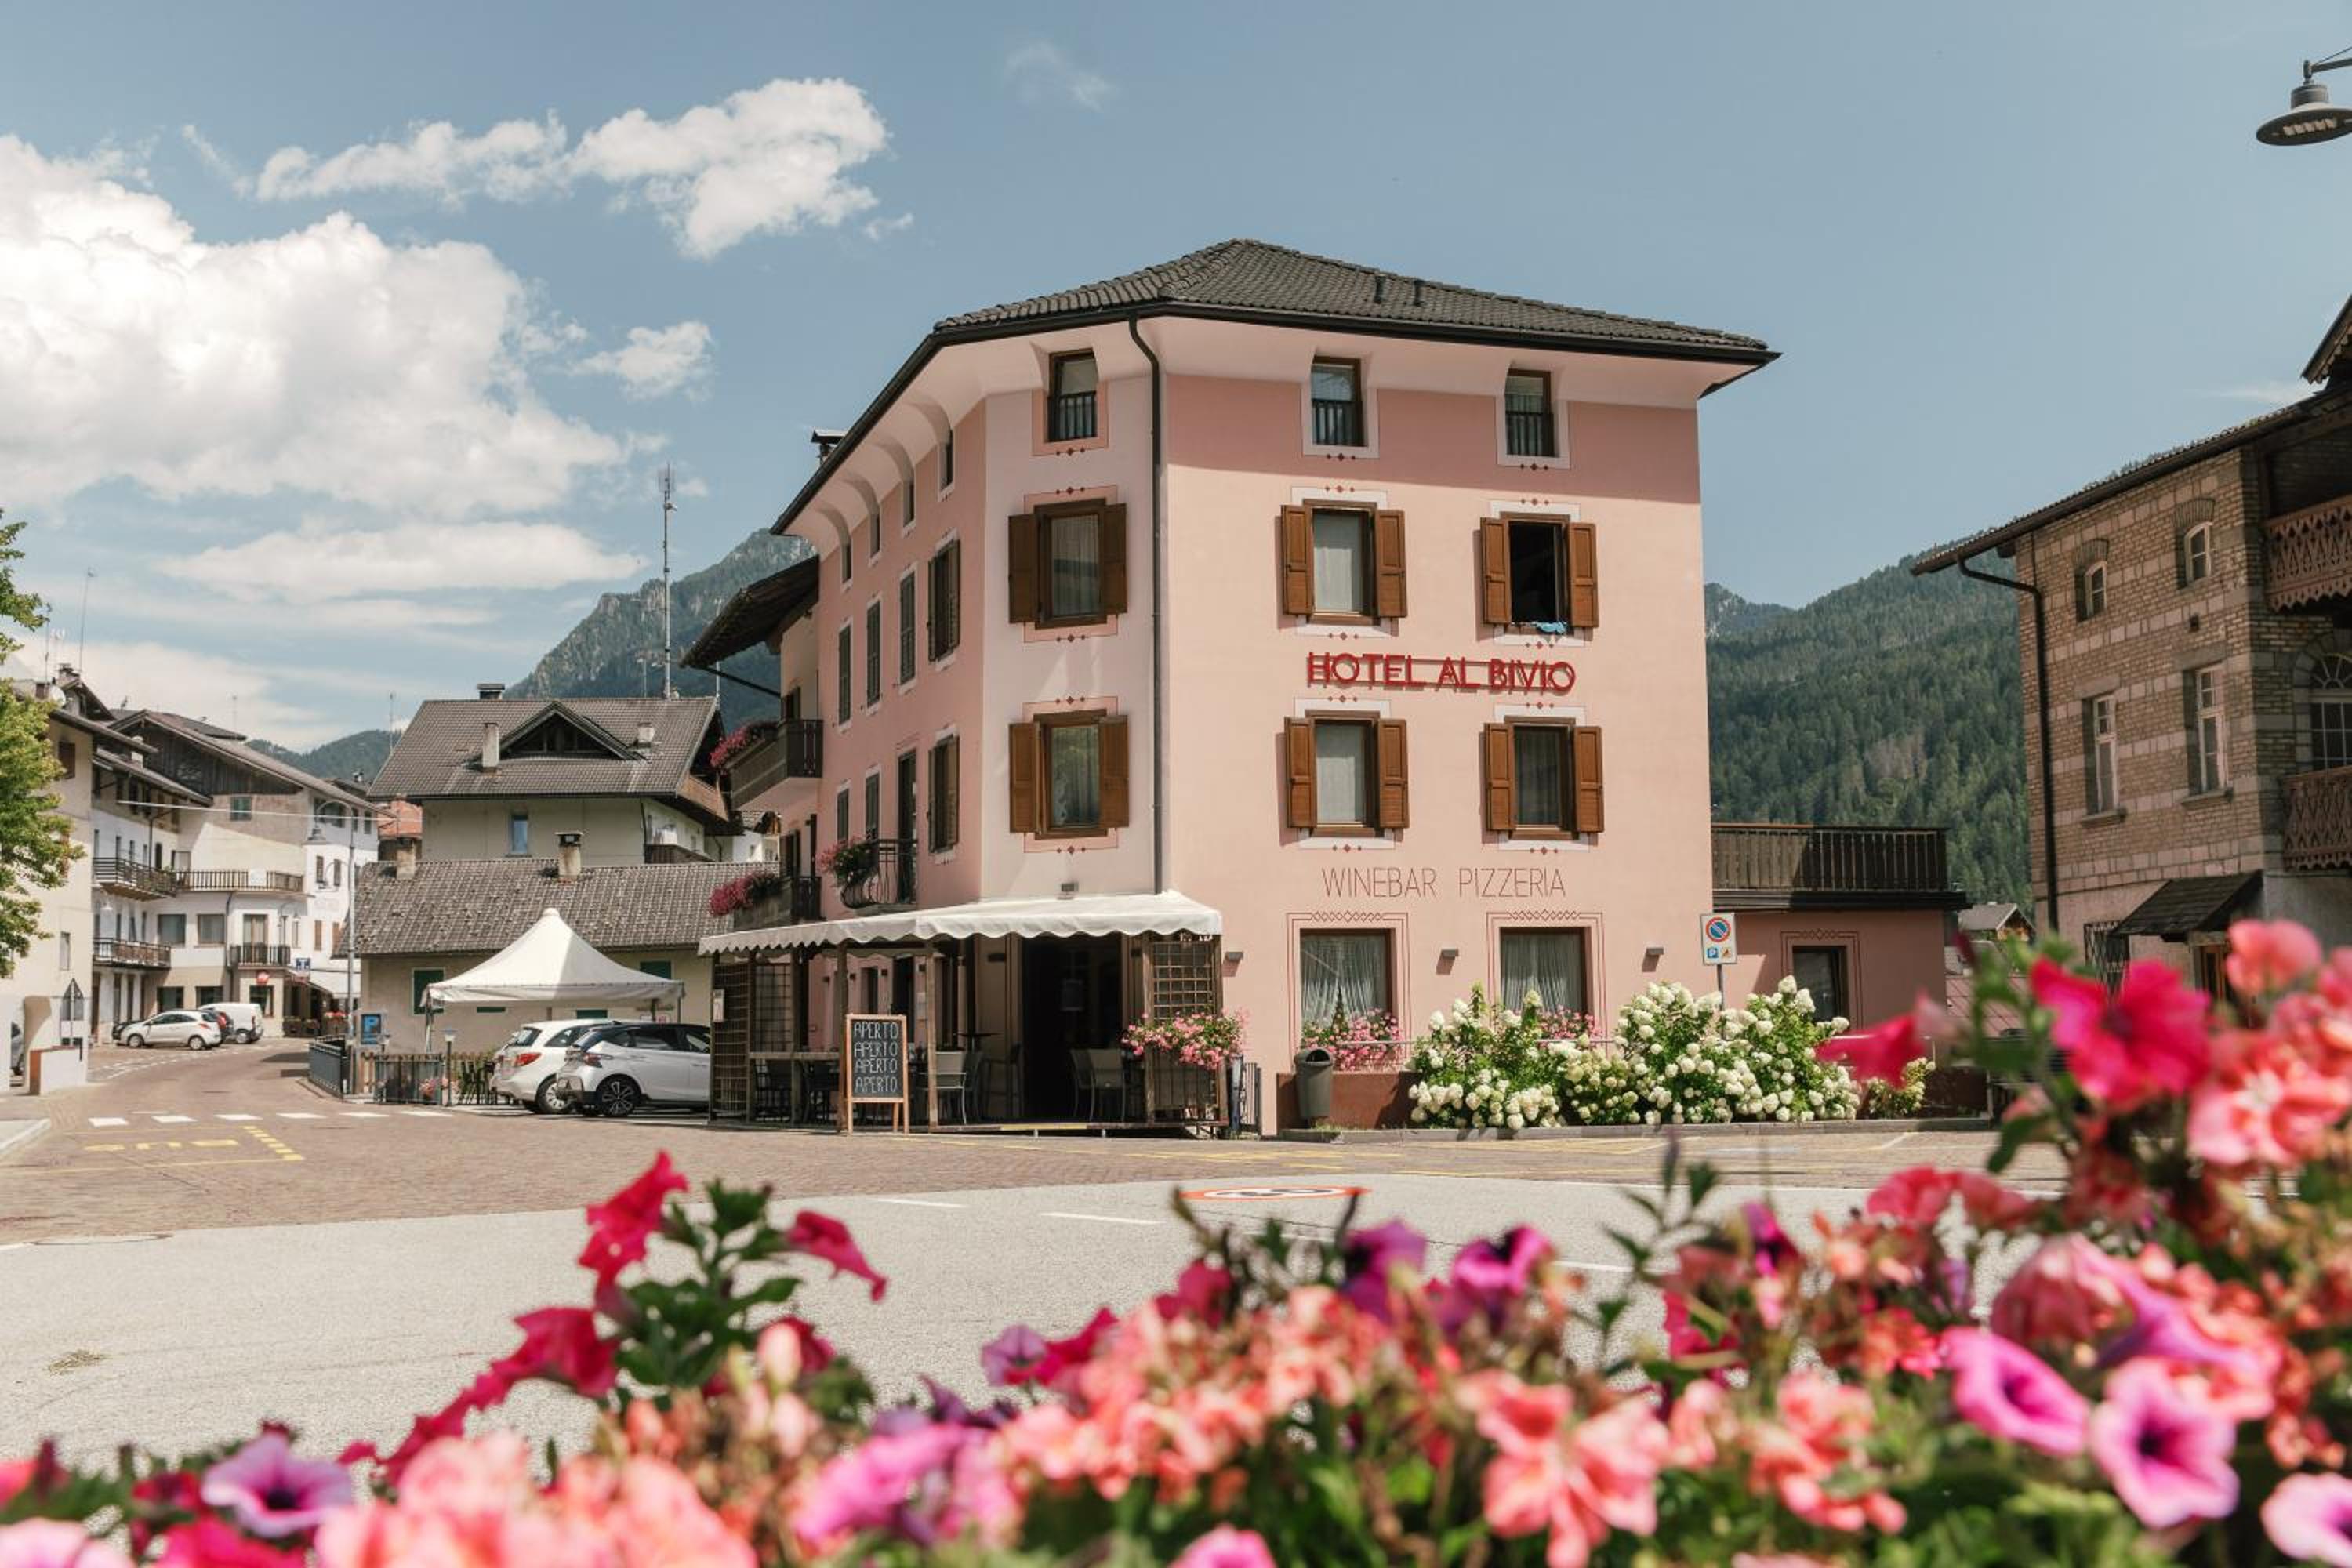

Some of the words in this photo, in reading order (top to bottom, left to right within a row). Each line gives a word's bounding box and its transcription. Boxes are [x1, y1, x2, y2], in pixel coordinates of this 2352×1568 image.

[1307, 652, 1427, 688] HOTEL
[1436, 656, 1481, 691] AL
[1489, 658, 1576, 694] BIVIO
[1321, 866, 1437, 898] WINEBAR
[1458, 867, 1566, 898] PIZZERIA
[365, 1015, 379, 1033] P
[853, 1022, 899, 1039] APERTO
[854, 1041, 898, 1058] APERTO
[854, 1058, 898, 1073] APERTO
[854, 1076, 898, 1094] APERTO
